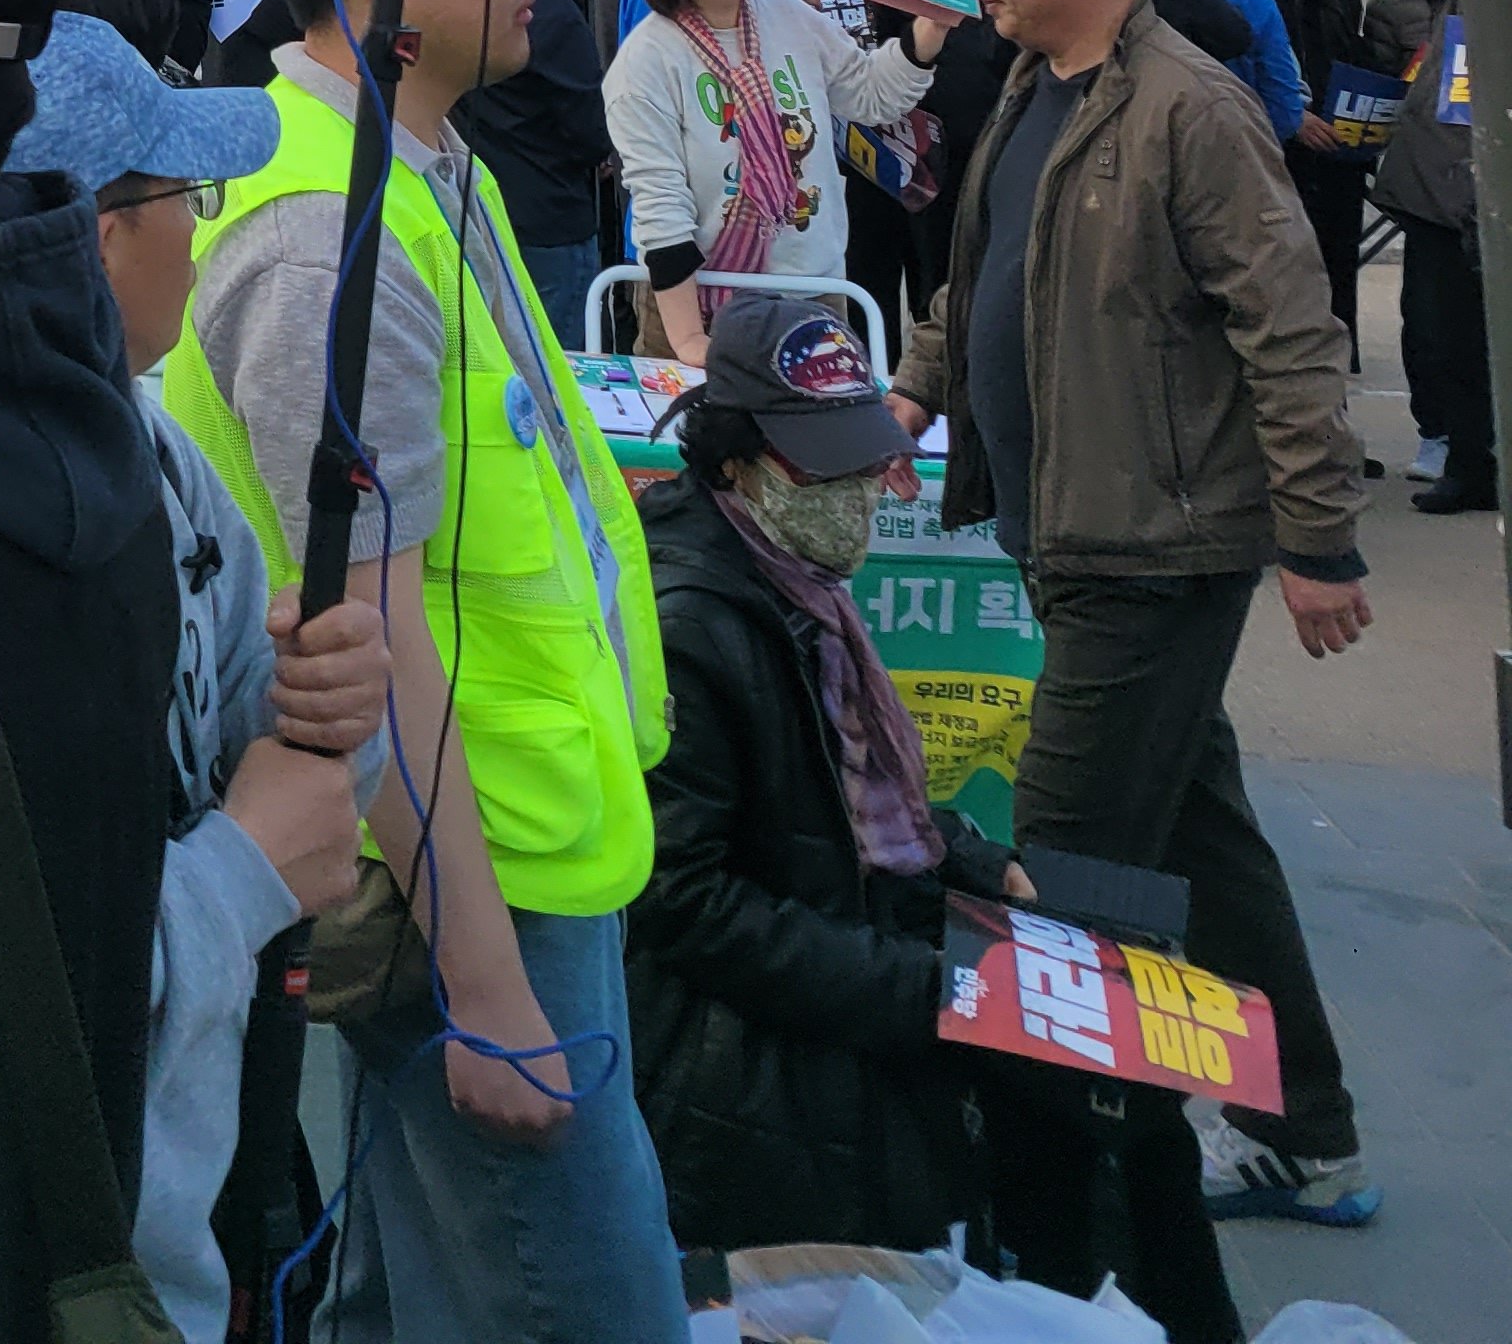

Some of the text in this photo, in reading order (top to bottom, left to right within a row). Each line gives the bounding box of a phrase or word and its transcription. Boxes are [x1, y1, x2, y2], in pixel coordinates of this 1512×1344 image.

[876, 514, 915, 539] 입법
[914, 681, 1022, 712] 우리의 요구
